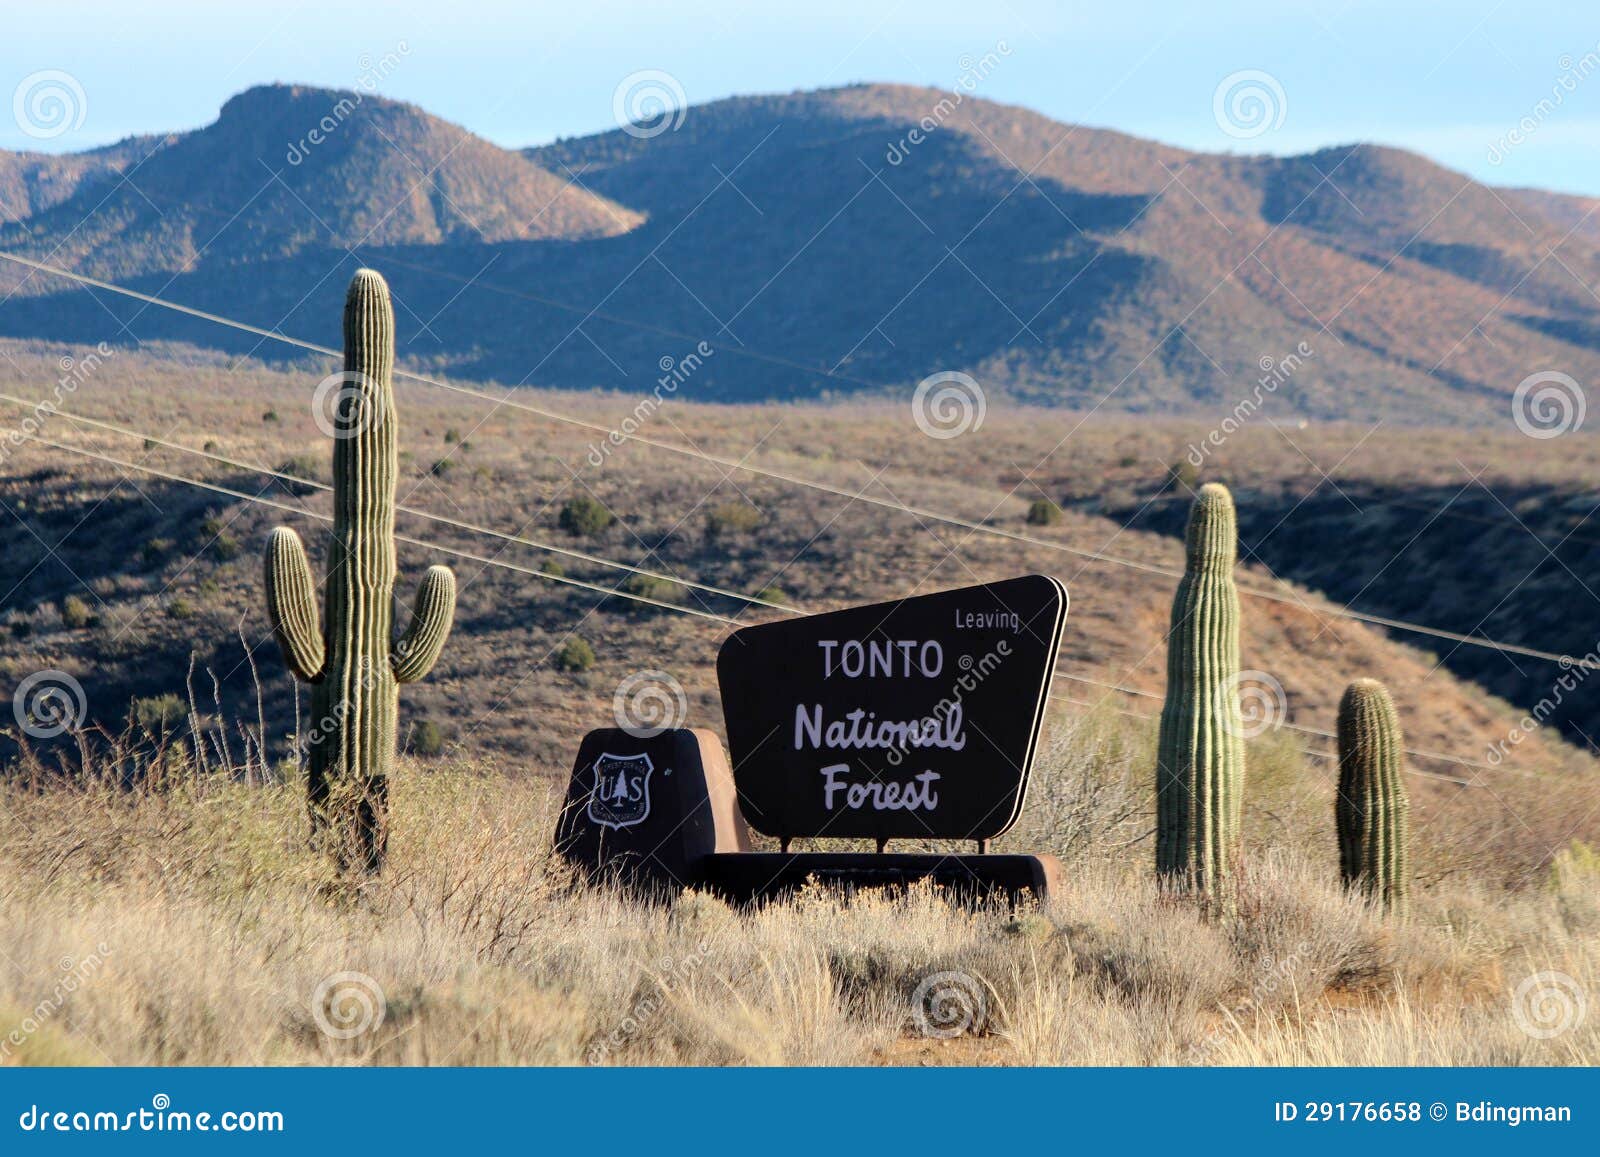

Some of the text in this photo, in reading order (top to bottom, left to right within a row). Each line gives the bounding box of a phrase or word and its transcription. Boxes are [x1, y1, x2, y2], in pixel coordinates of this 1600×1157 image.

[955, 608, 1019, 634] Leaving
[818, 640, 943, 679] TONTO
[795, 703, 966, 751] National
[820, 763, 941, 811] Forest
